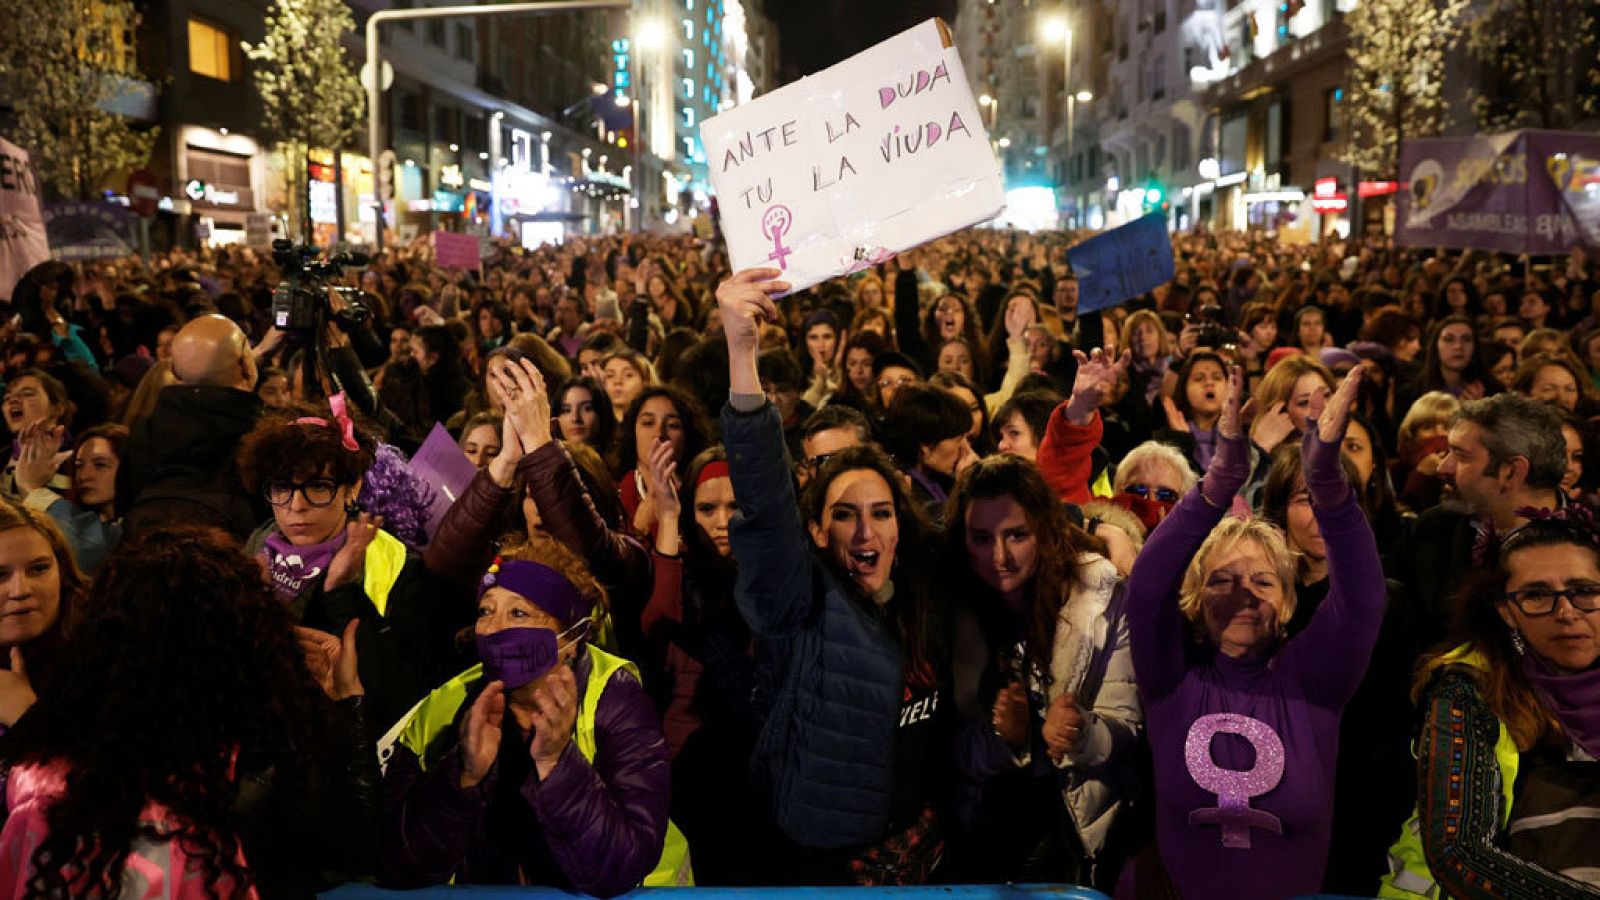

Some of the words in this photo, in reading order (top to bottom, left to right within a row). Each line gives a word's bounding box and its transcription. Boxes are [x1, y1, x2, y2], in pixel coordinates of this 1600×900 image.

[722, 119, 798, 173] ANTE
[825, 112, 861, 144] LA
[878, 60, 951, 110] DUDA
[739, 178, 775, 209] TU
[812, 155, 857, 192] LA
